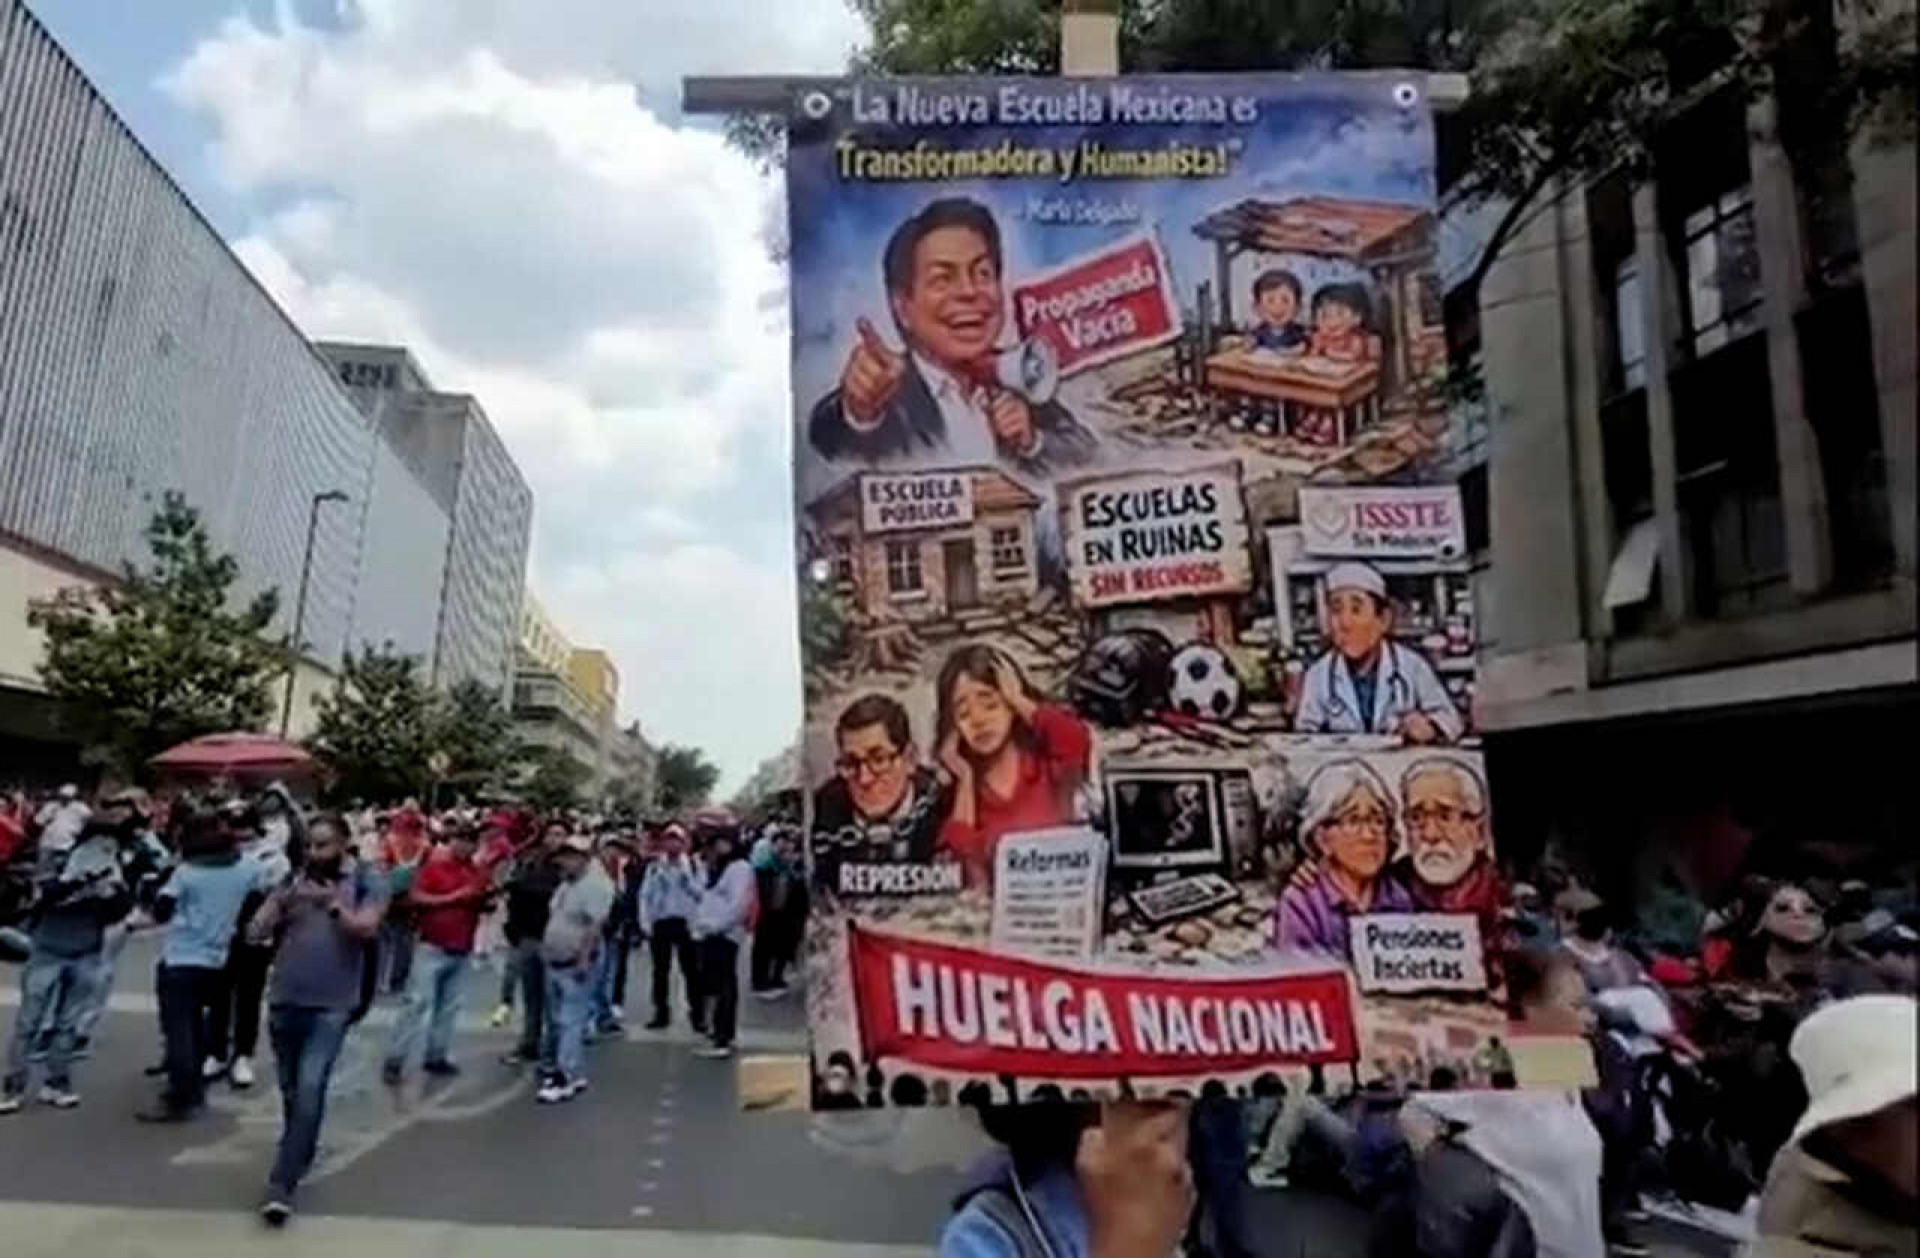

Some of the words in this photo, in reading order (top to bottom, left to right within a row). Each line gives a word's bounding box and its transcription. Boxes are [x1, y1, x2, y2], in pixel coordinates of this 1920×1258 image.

[896, 86, 989, 124] Nueva
[999, 86, 1101, 122] Escuela
[1109, 88, 1226, 121] Mexicana
[1231, 96, 1258, 118] es
[836, 139, 1054, 180] Transformadora
[1058, 148, 1074, 182] y
[1020, 258, 1156, 328] Propaganda
[868, 477, 964, 503] ESCUELA
[1081, 483, 1217, 528] ESCUELAS
[1354, 501, 1452, 529] ISSSTE
[1084, 541, 1114, 566] EN
[1120, 520, 1224, 562] RUINAS
[1088, 571, 1126, 598] SIN
[1132, 561, 1225, 592] RECURSOS
[1007, 846, 1091, 873] Reformas
[1366, 923, 1465, 951] Pensiones
[1373, 953, 1464, 980] Inciertas
[891, 953, 1120, 1055] HUELGA
[1127, 992, 1336, 1056] NACIONAL
